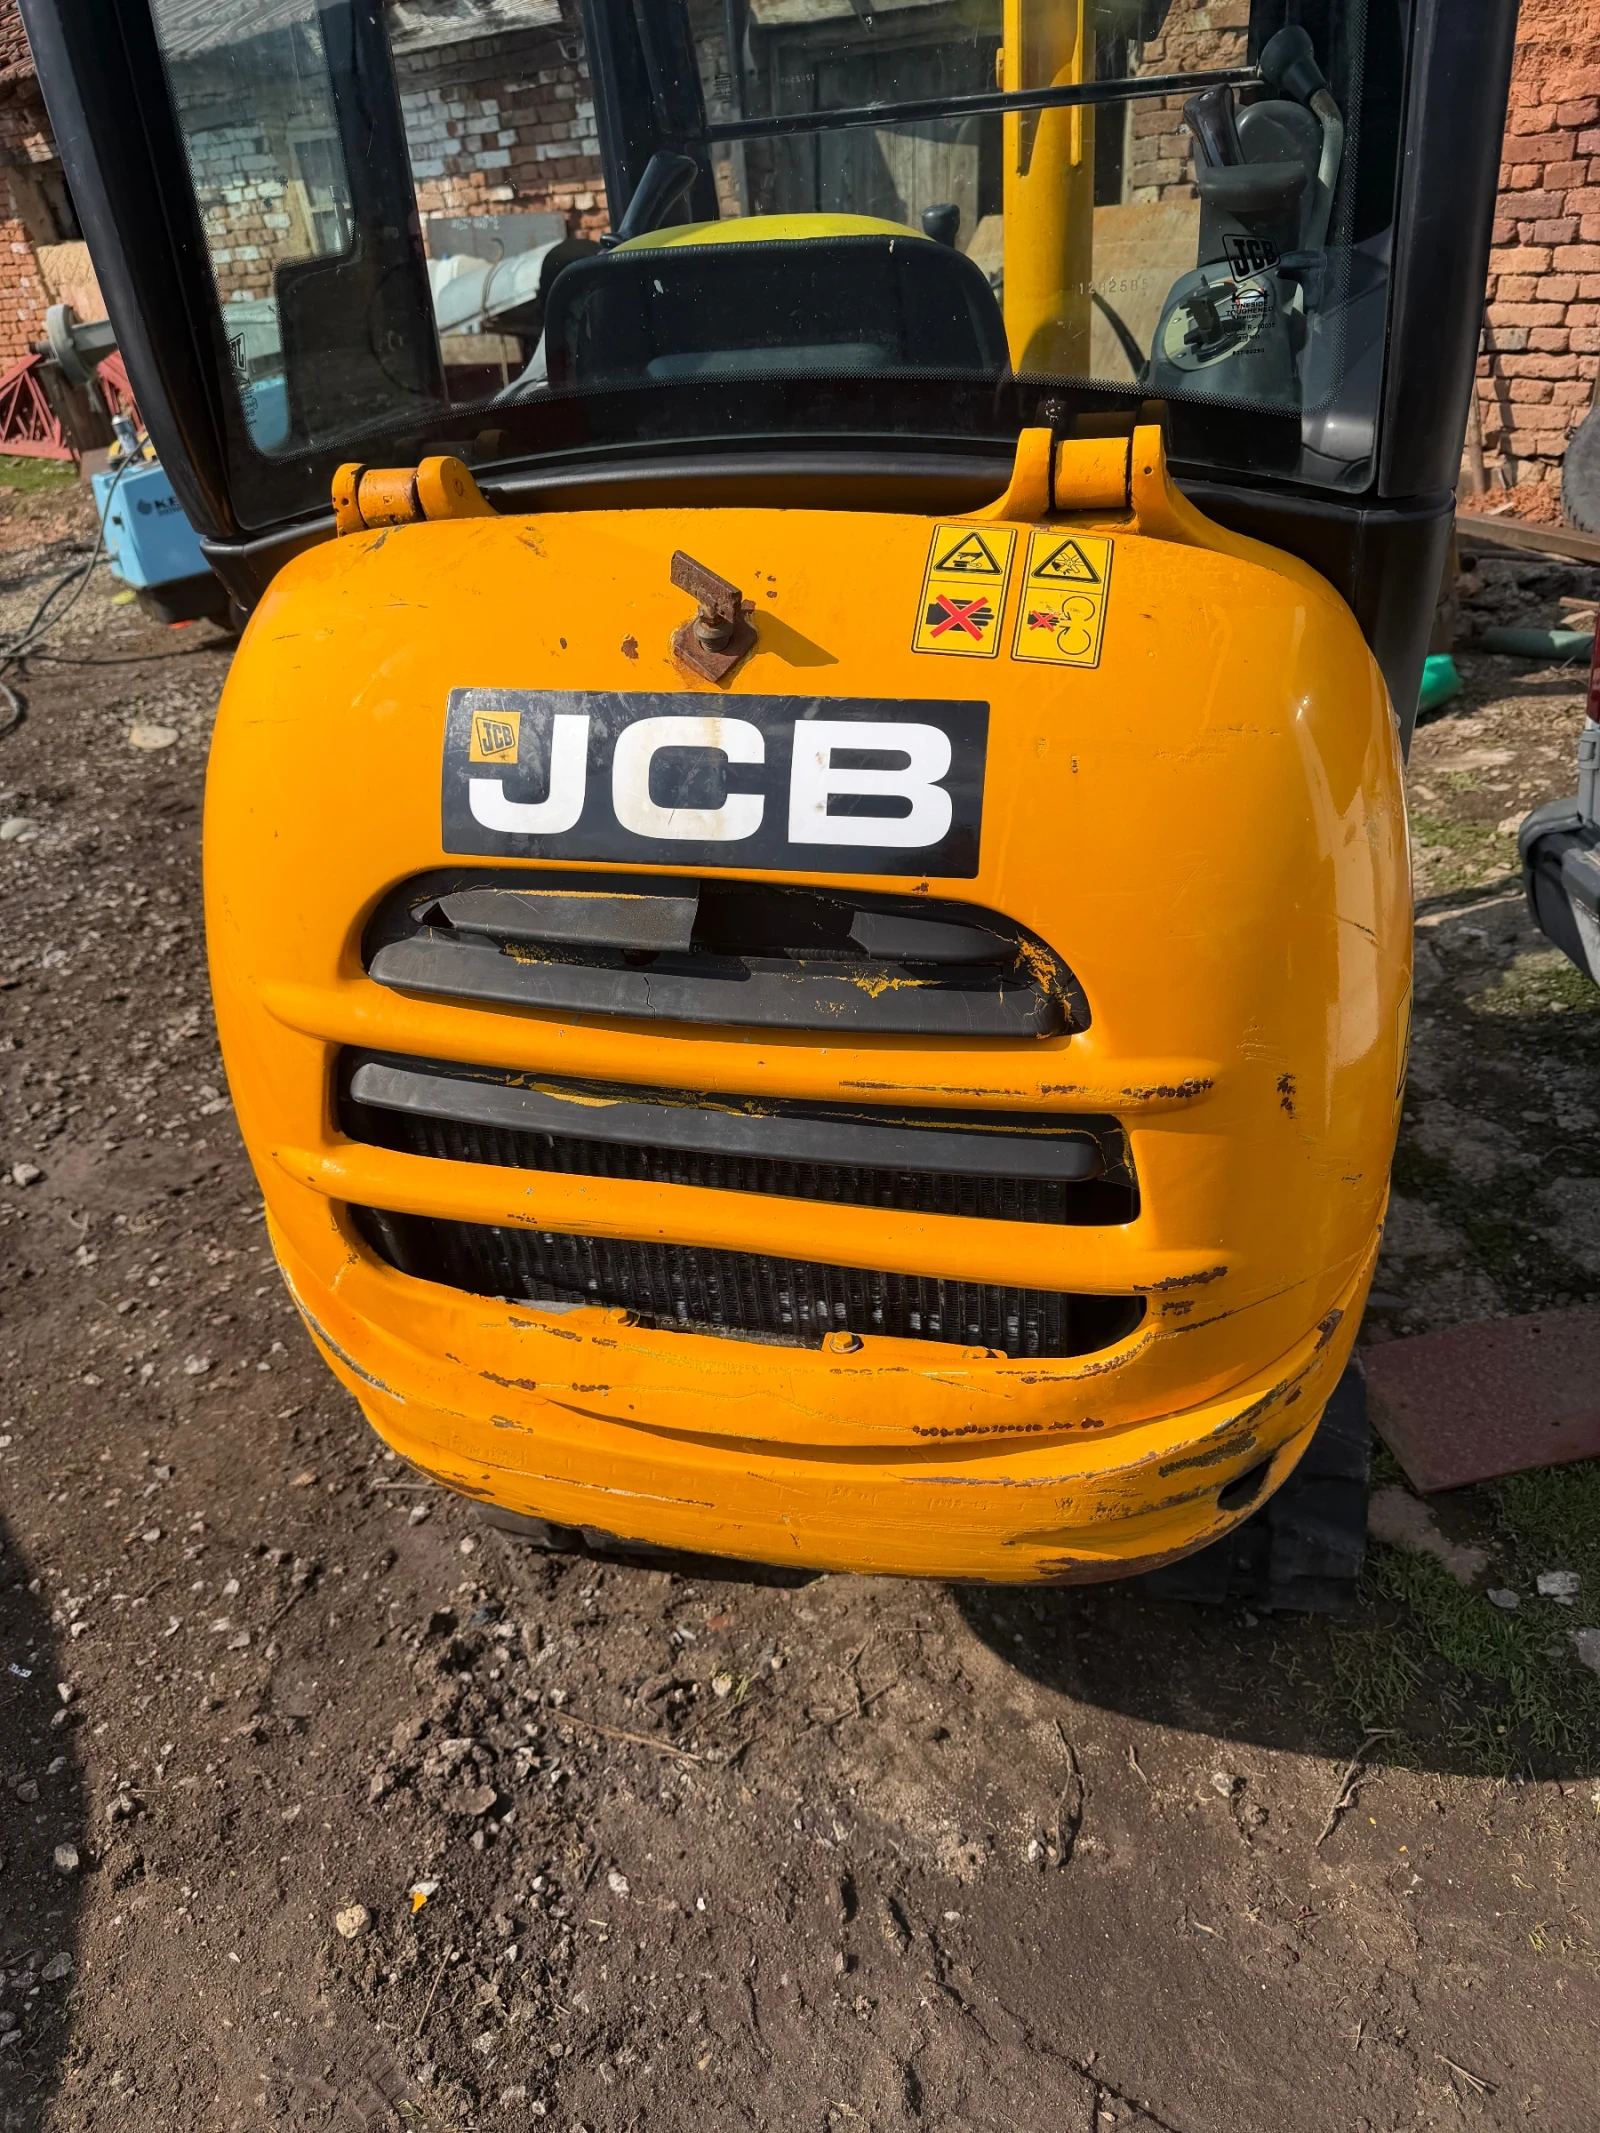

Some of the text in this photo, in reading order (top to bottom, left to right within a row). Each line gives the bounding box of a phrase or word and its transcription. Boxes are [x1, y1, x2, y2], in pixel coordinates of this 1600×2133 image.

[1232, 238, 1277, 277] JCB
[1226, 306, 1273, 316] TOUGHENED
[1231, 301, 1268, 310] TYNESIDE
[482, 721, 513, 752] JCB
[469, 714, 953, 848] JCB
